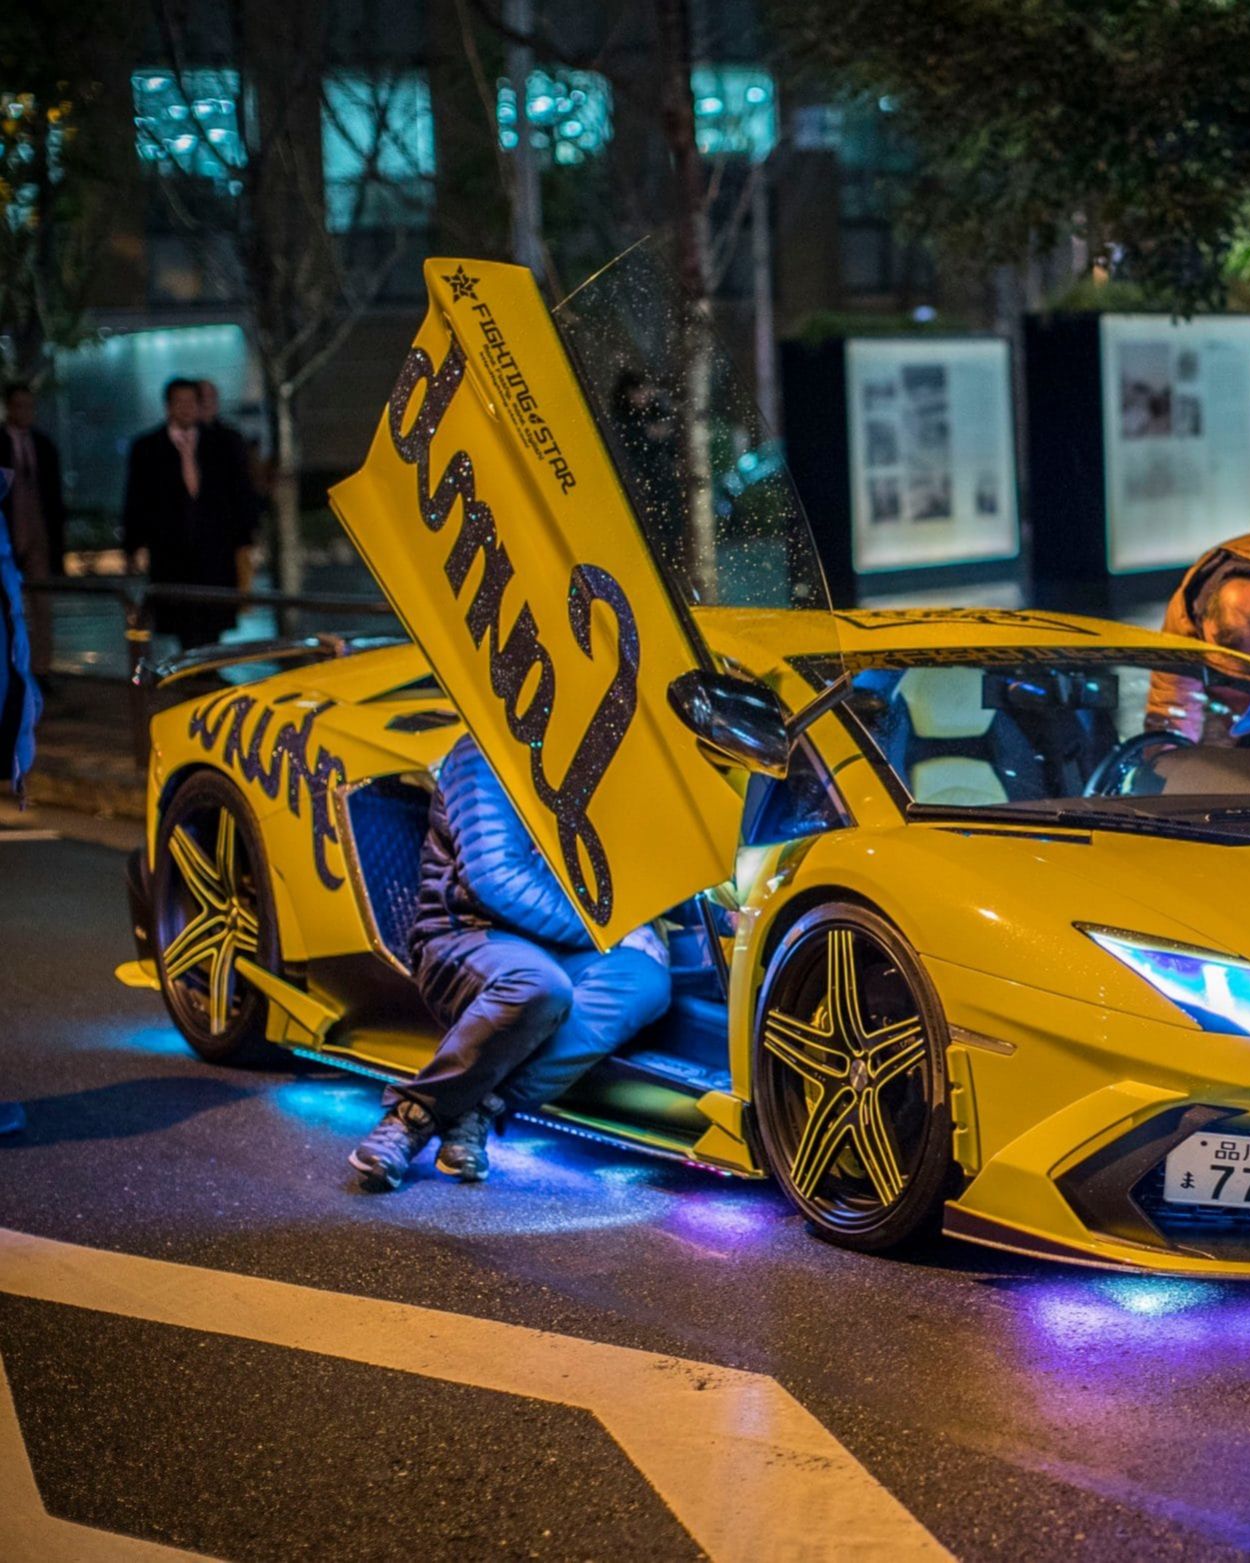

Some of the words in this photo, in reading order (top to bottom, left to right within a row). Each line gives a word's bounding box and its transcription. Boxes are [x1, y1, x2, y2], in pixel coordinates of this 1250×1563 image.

[472, 303, 538, 413] FIGHTING
[533, 426, 577, 496] STAR
[1180, 1171, 1195, 1189] ま
